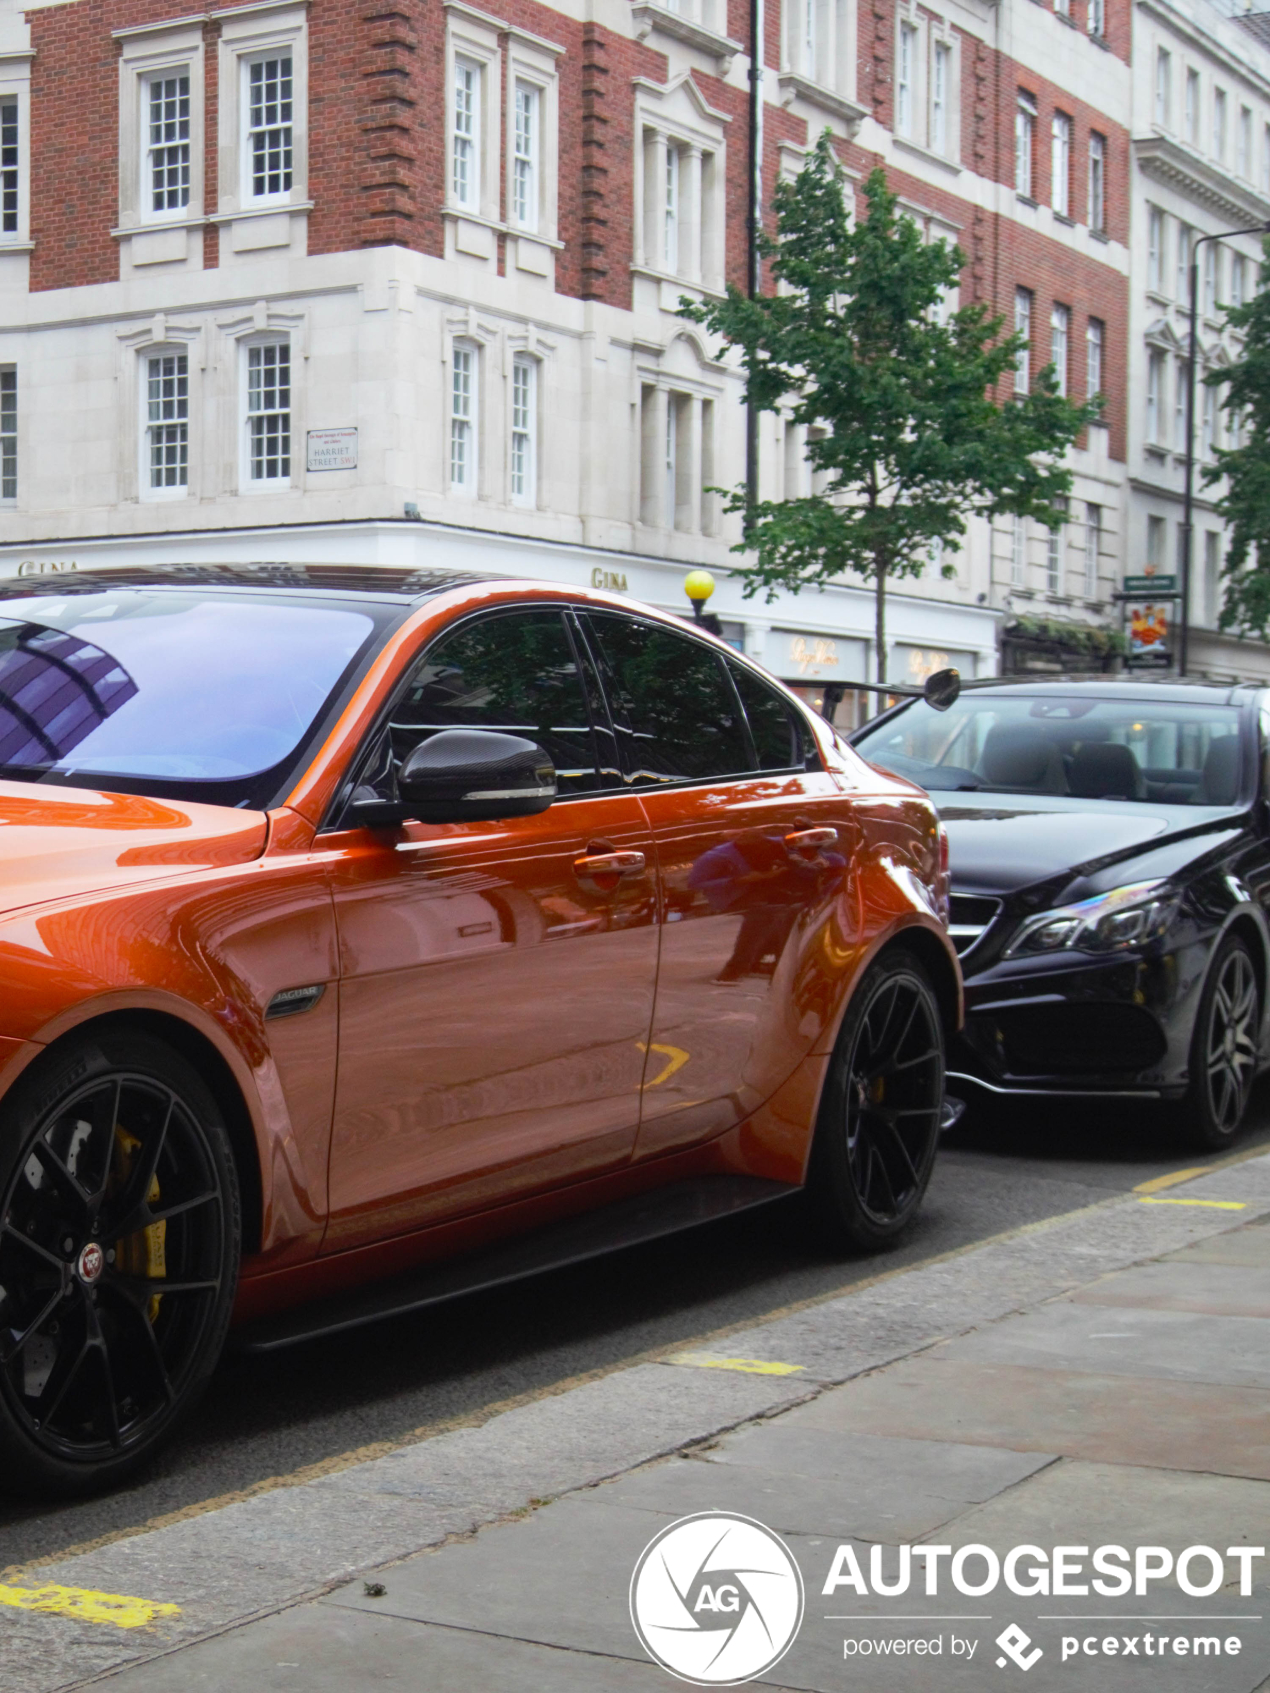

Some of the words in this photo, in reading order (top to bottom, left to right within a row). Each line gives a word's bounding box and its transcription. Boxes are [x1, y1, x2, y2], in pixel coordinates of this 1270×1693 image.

[314, 447, 349, 457] HARRIET
[308, 457, 338, 466] STREET
[591, 567, 629, 591] GINA
[275, 986, 318, 1002] JAGUAR
